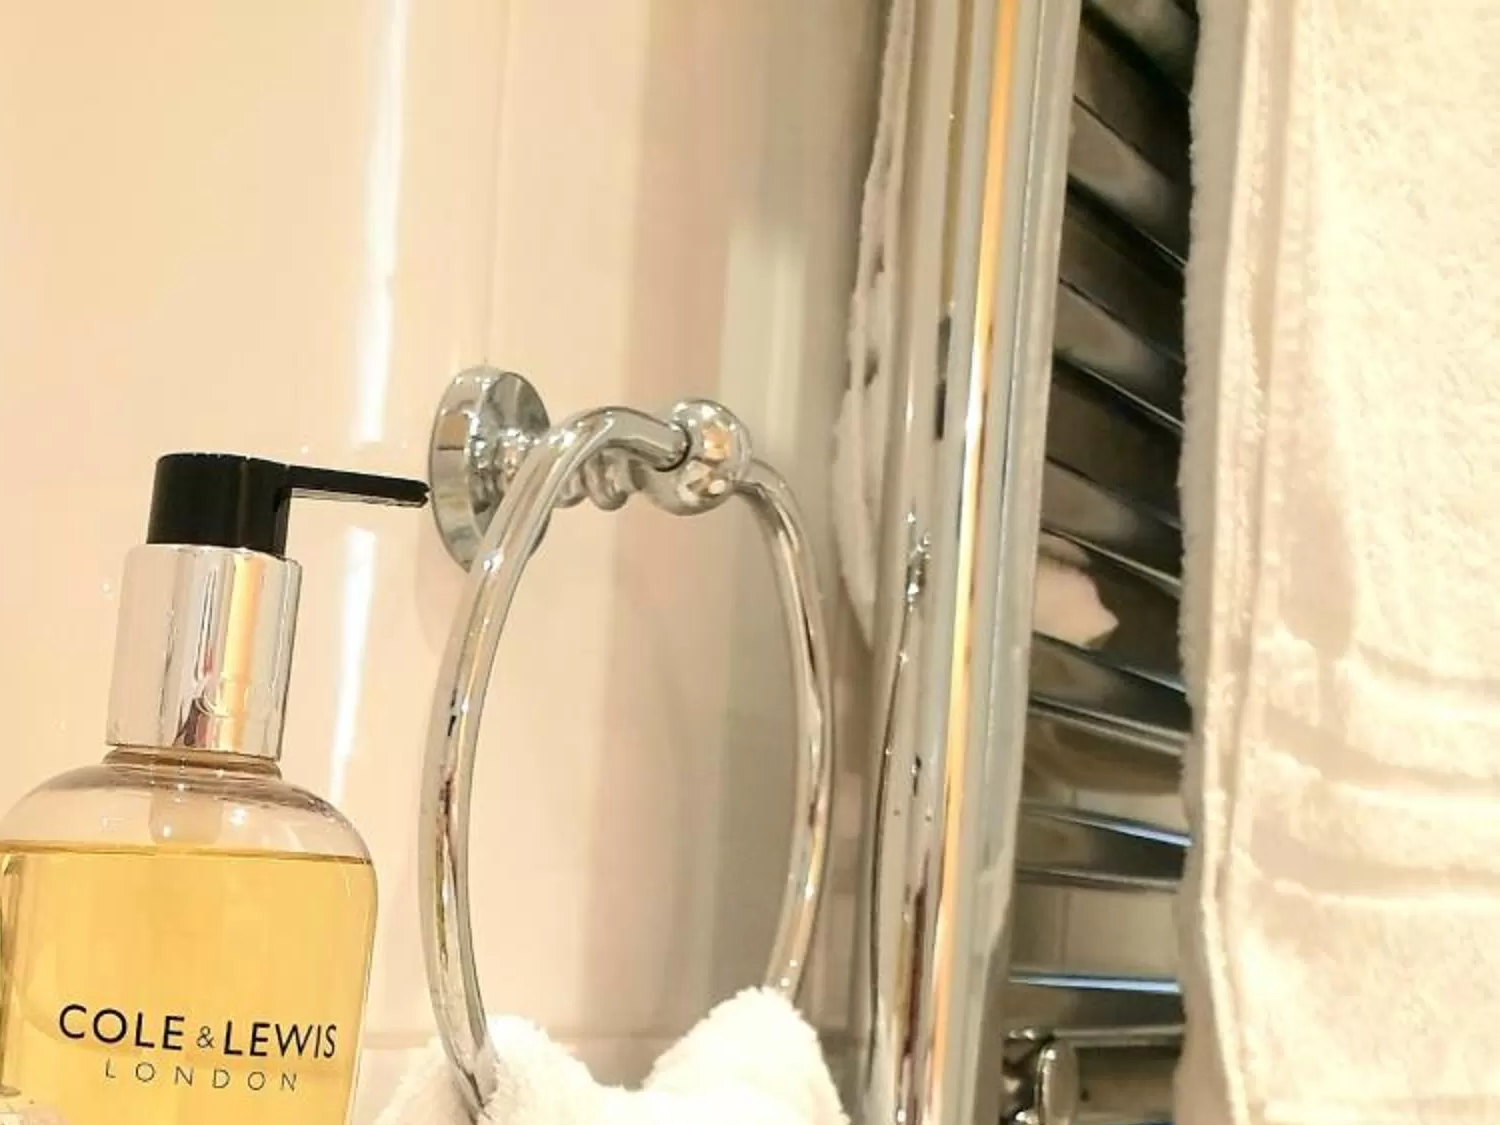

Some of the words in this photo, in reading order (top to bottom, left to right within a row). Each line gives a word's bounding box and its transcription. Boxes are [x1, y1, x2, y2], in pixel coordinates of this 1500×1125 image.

[59, 1003, 185, 1051] COLE
[195, 1024, 215, 1050] &
[222, 1020, 337, 1059] LEWIS
[104, 1057, 297, 1092] LONDON
